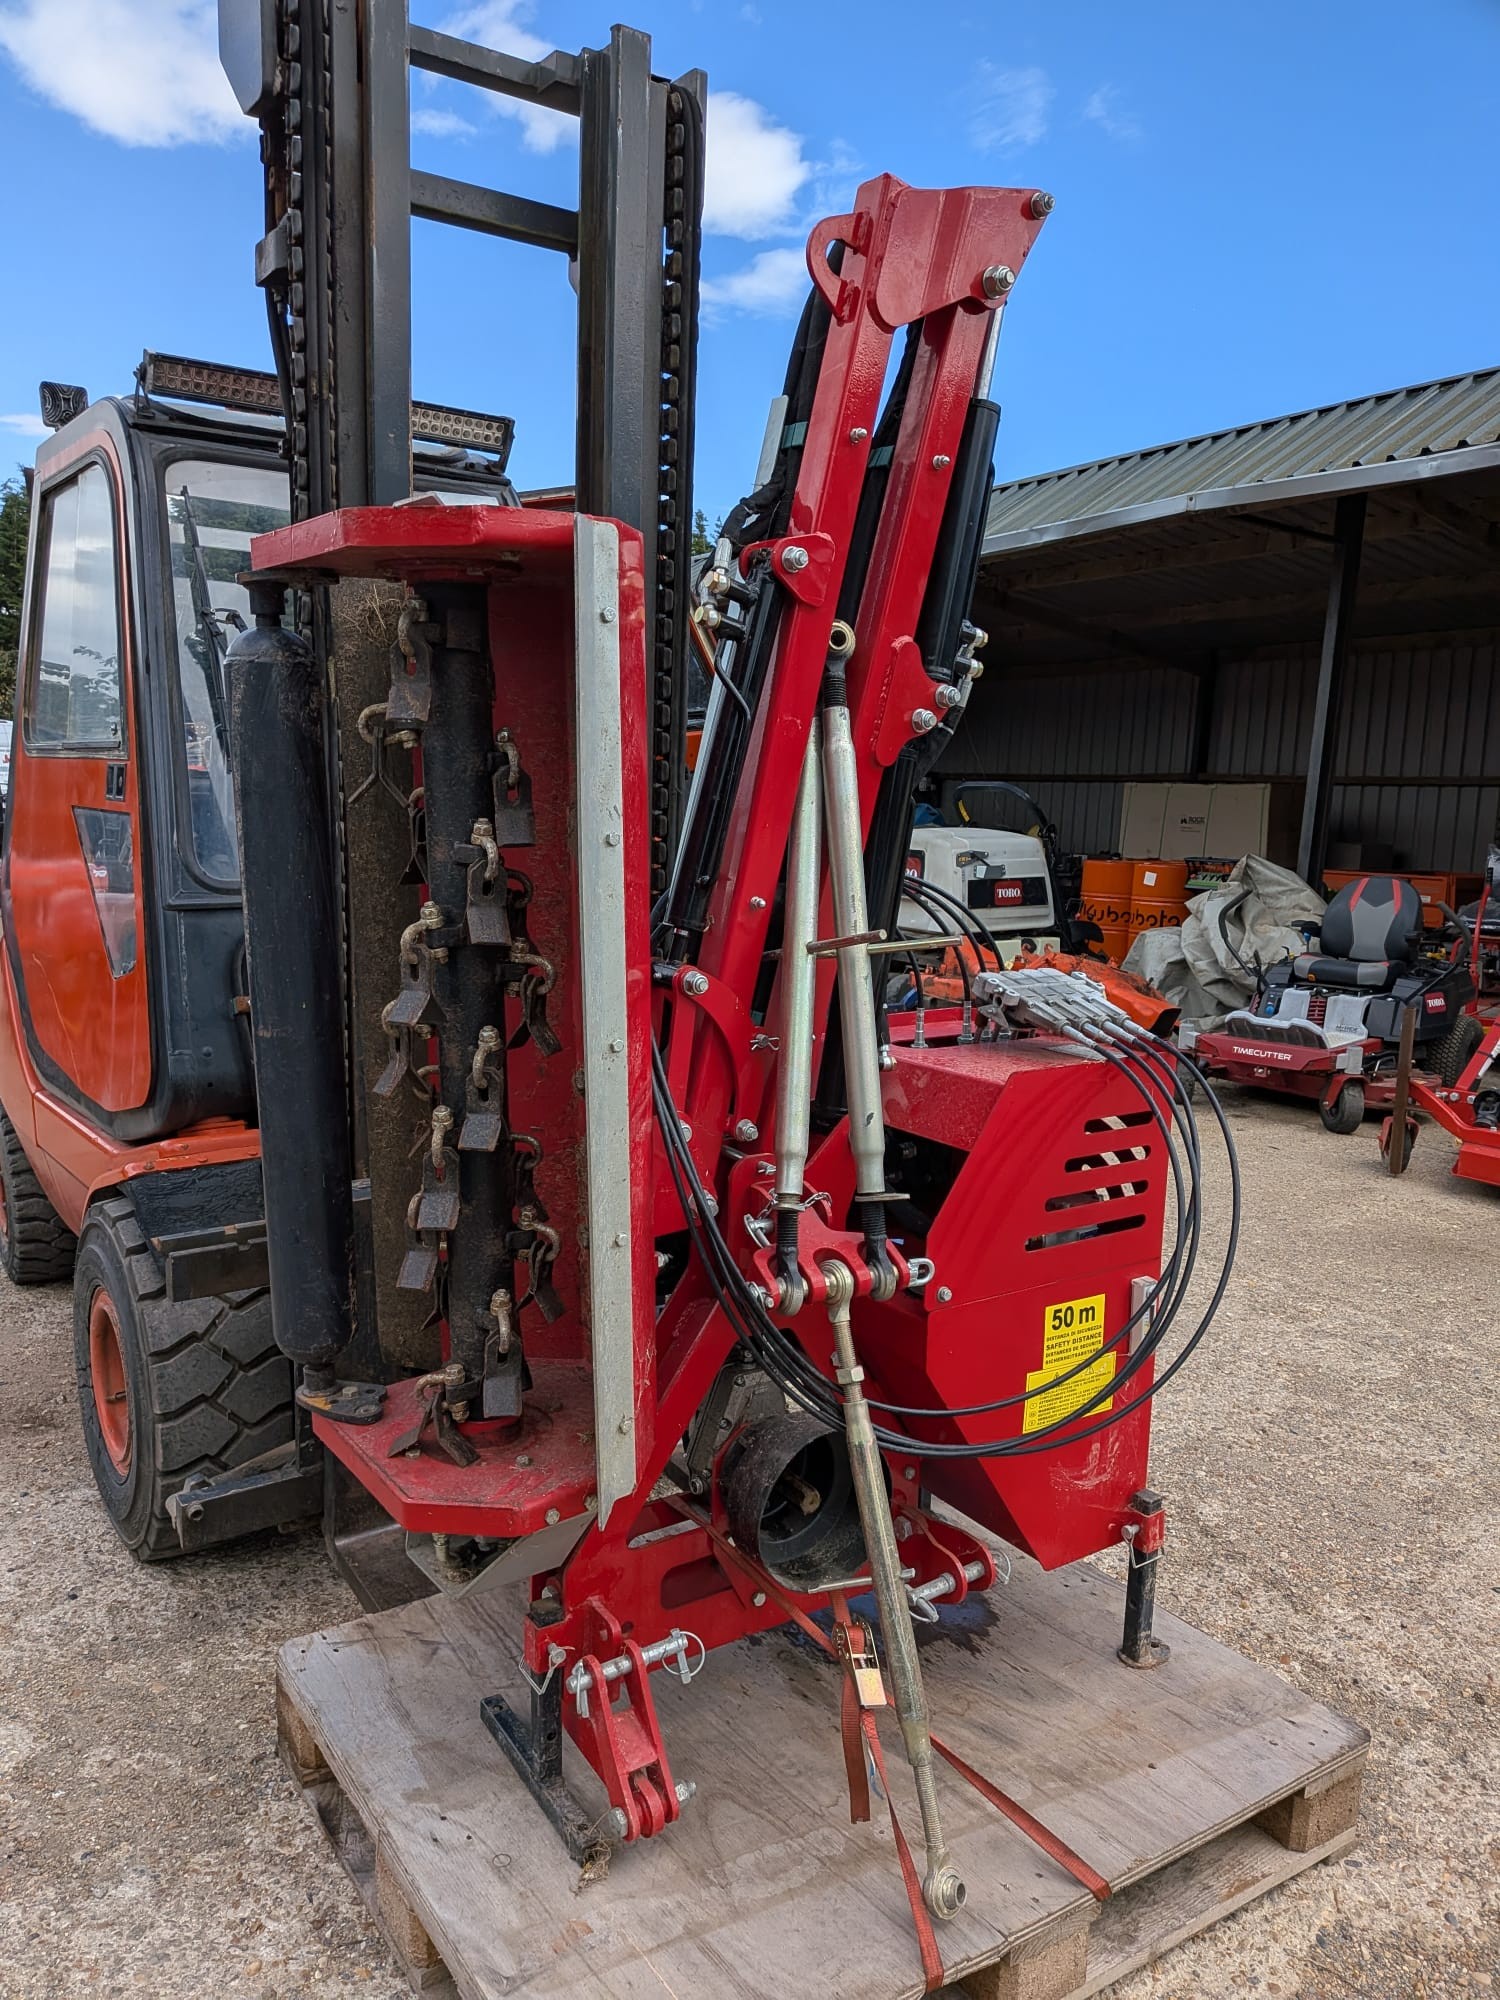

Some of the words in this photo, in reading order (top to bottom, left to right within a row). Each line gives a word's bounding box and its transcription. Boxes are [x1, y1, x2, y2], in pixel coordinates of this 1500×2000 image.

[997, 887, 1021, 898] TORO
[1427, 998, 1446, 1007] TORO
[1233, 1046, 1293, 1060] TIMECUTTER
[1052, 1306, 1074, 1331] 50
[1079, 1305, 1096, 1324] m
[1046, 1340, 1071, 1351] SAFETY
[1072, 1332, 1102, 1345] DISTANCE
